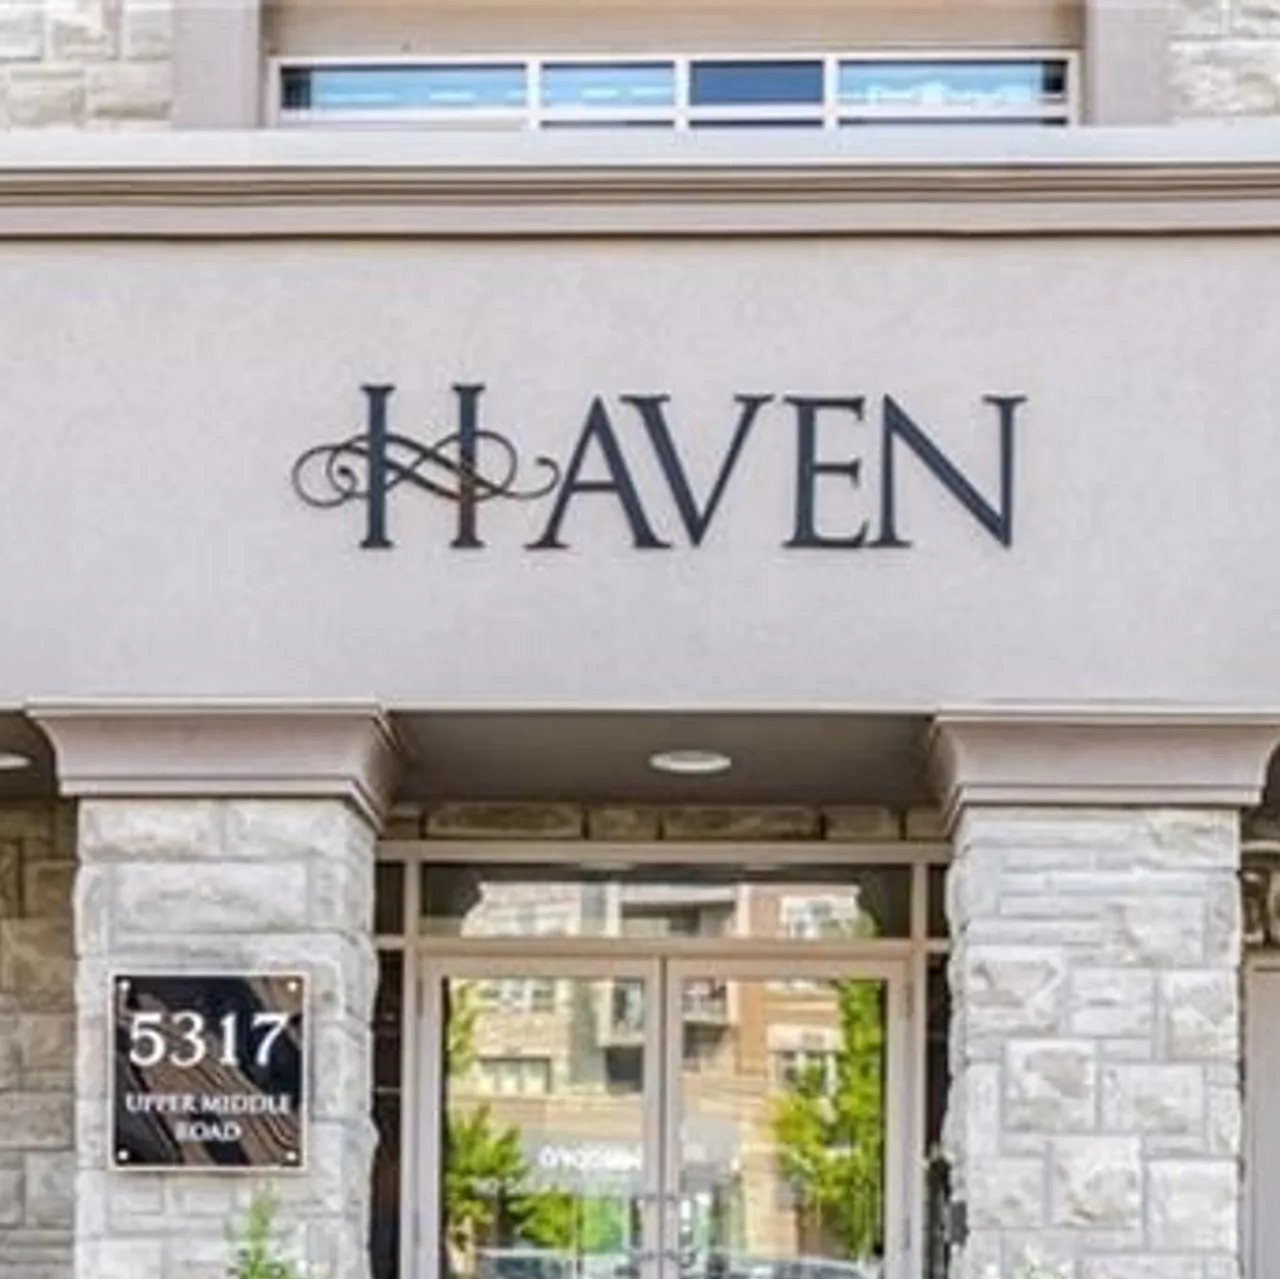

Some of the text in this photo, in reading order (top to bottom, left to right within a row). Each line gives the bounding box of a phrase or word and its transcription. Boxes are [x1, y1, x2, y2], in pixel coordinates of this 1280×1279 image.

[292, 383, 1027, 551] HAVEN
[129, 1010, 290, 1067] 5317
[125, 1093, 291, 1115] UPPER MIDDLE
[174, 1120, 242, 1142] ROAD
